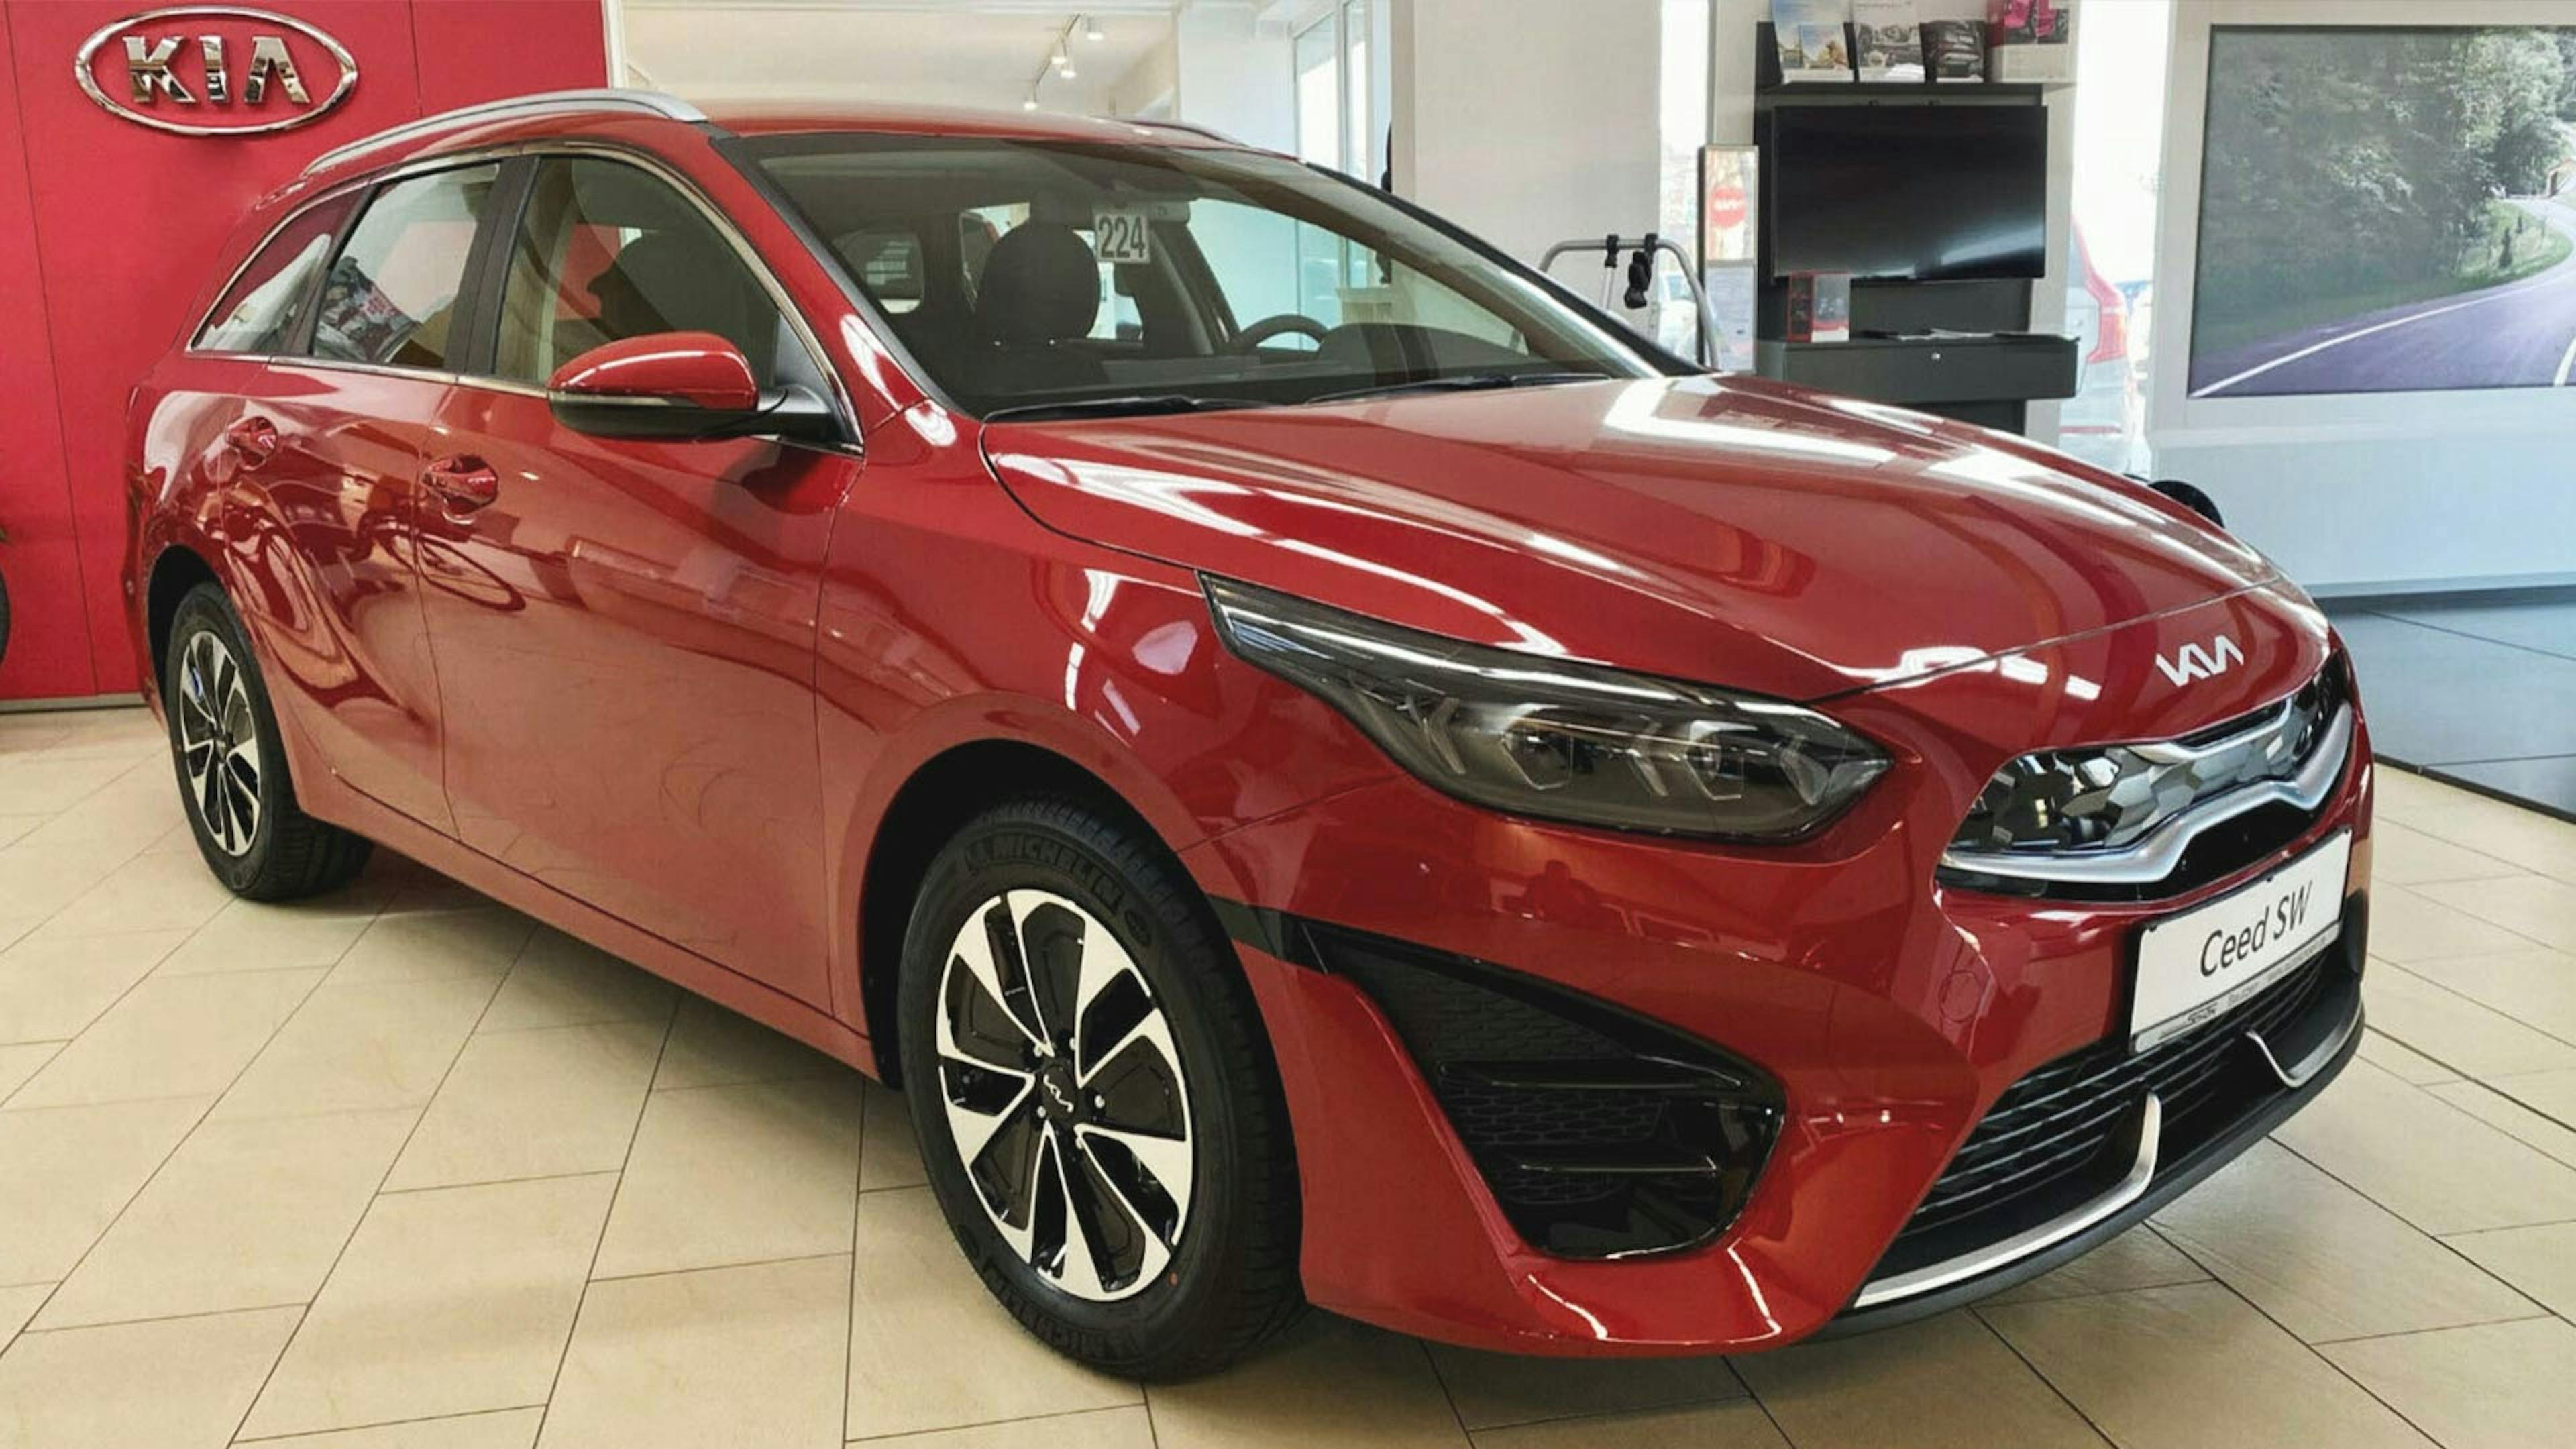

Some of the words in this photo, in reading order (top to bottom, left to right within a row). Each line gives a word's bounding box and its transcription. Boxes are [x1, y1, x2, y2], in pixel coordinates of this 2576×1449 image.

[122, 35, 312, 105] KIA
[1098, 215, 1146, 258] 224
[2155, 635, 2245, 687] KIA
[991, 835, 1125, 913] MICHELIN
[2200, 906, 2269, 977] Ceed
[2273, 880, 2313, 941] SW
